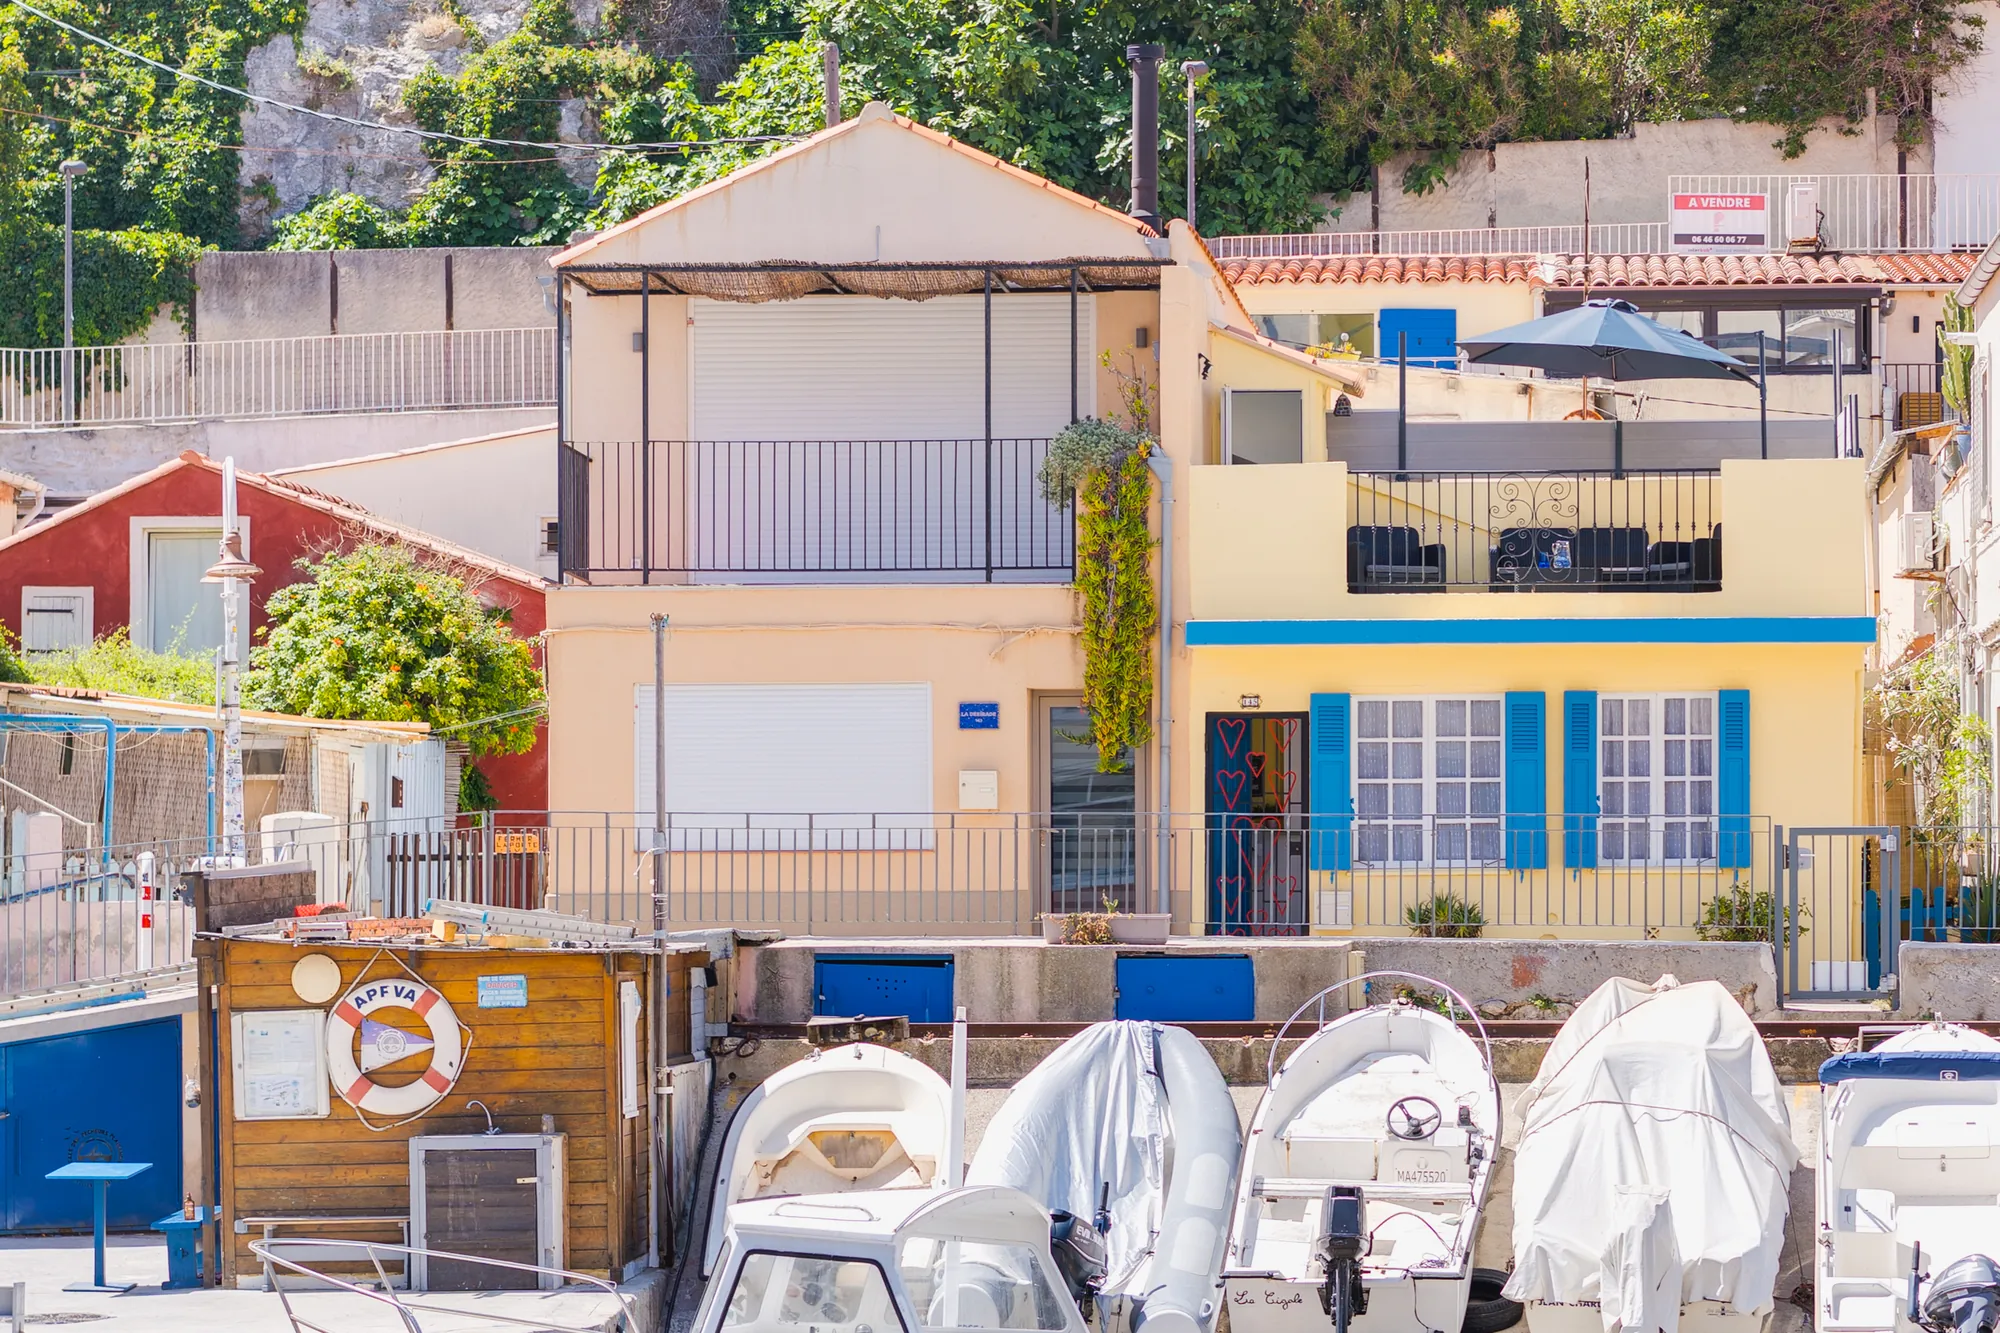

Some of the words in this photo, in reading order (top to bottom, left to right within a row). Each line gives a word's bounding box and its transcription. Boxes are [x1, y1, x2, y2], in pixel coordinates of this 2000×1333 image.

[1688, 197, 1698, 208] A
[1700, 197, 1751, 208] VENDRE
[1691, 235, 1702, 243] 06
[1702, 235, 1713, 243] 46
[1714, 235, 1725, 243] 60
[1725, 235, 1736, 243] 06
[1736, 235, 1747, 243] 77
[486, 981, 519, 989] DANGER
[354, 984, 416, 1009] APFVA
[1397, 1170, 1446, 1183] MA475520
[1233, 1290, 1255, 1305] La
[1264, 1289, 1303, 1311] Cigale
